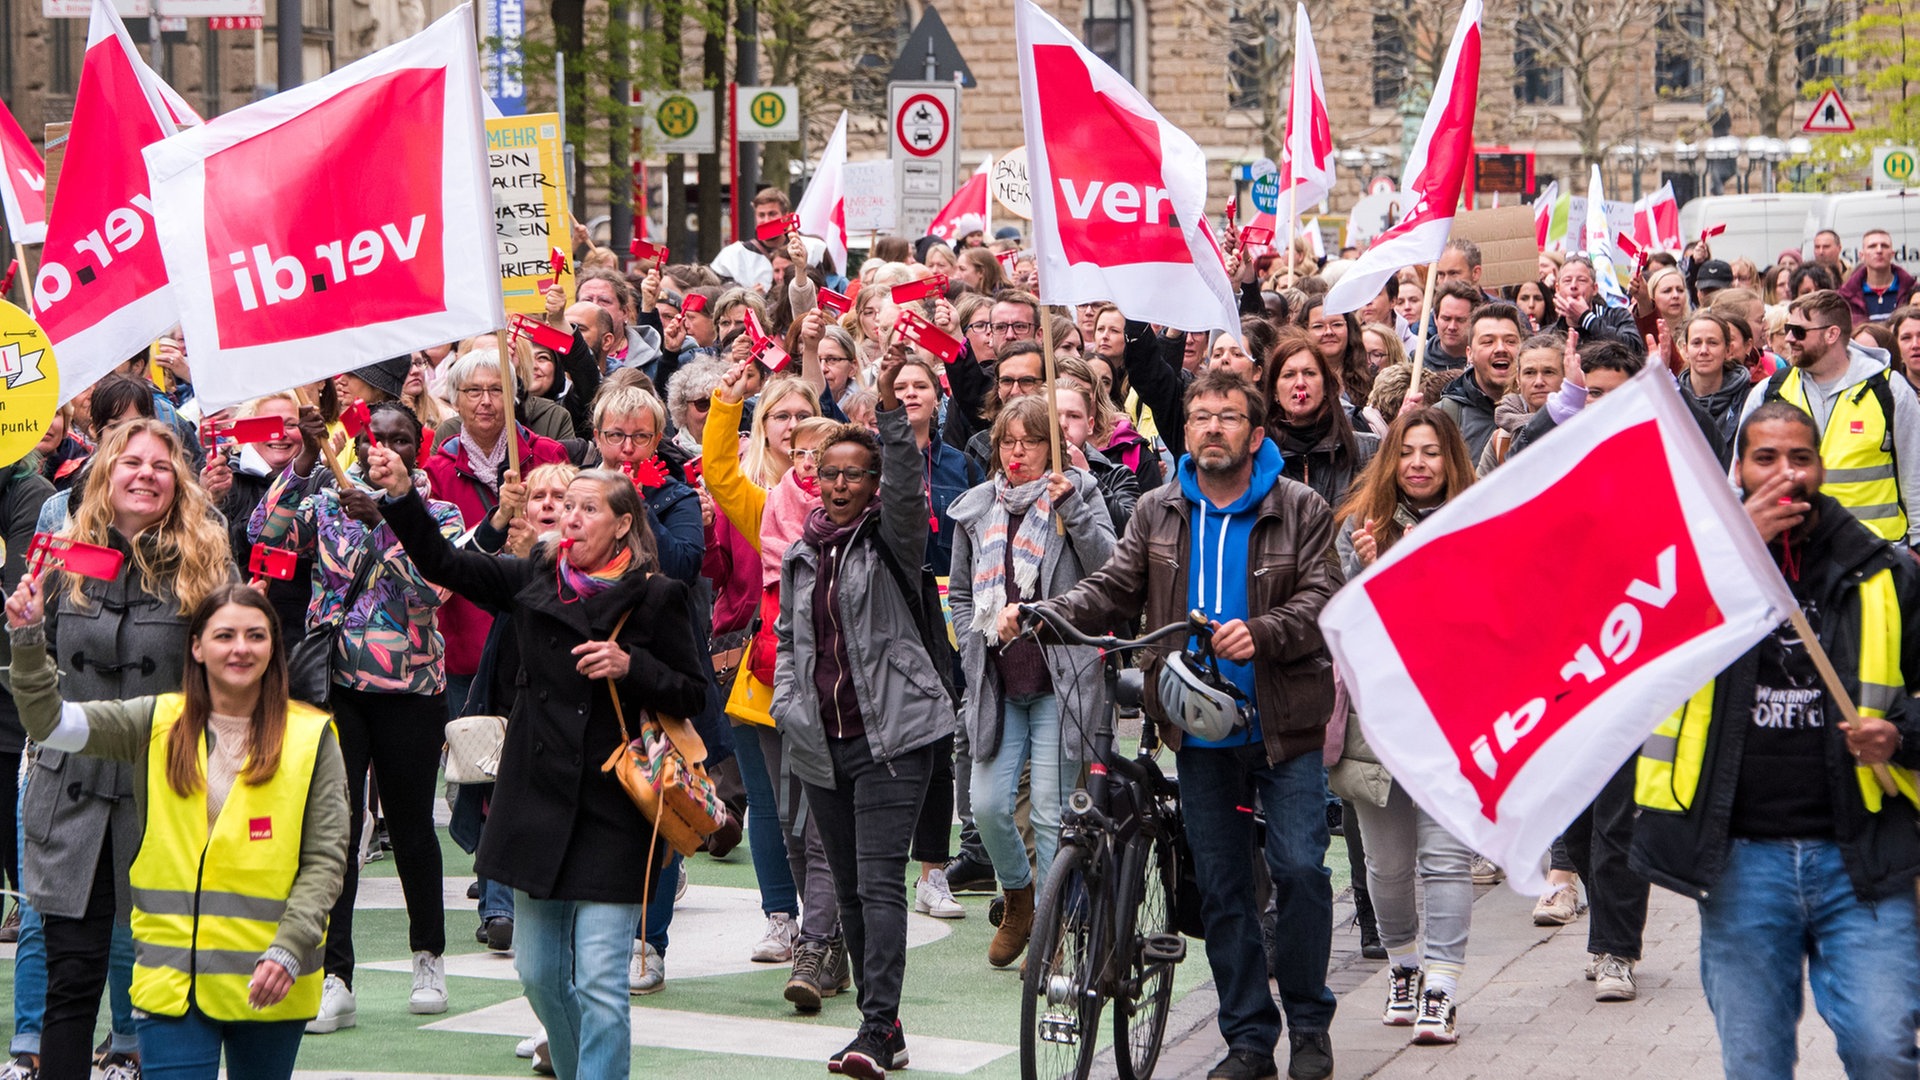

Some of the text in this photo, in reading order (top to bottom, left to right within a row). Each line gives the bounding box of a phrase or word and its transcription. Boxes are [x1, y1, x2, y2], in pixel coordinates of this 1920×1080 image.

[486, 127, 538, 148] MEHR
[1255, 184, 1278, 195] SIND
[1, 418, 39, 436] punkt
